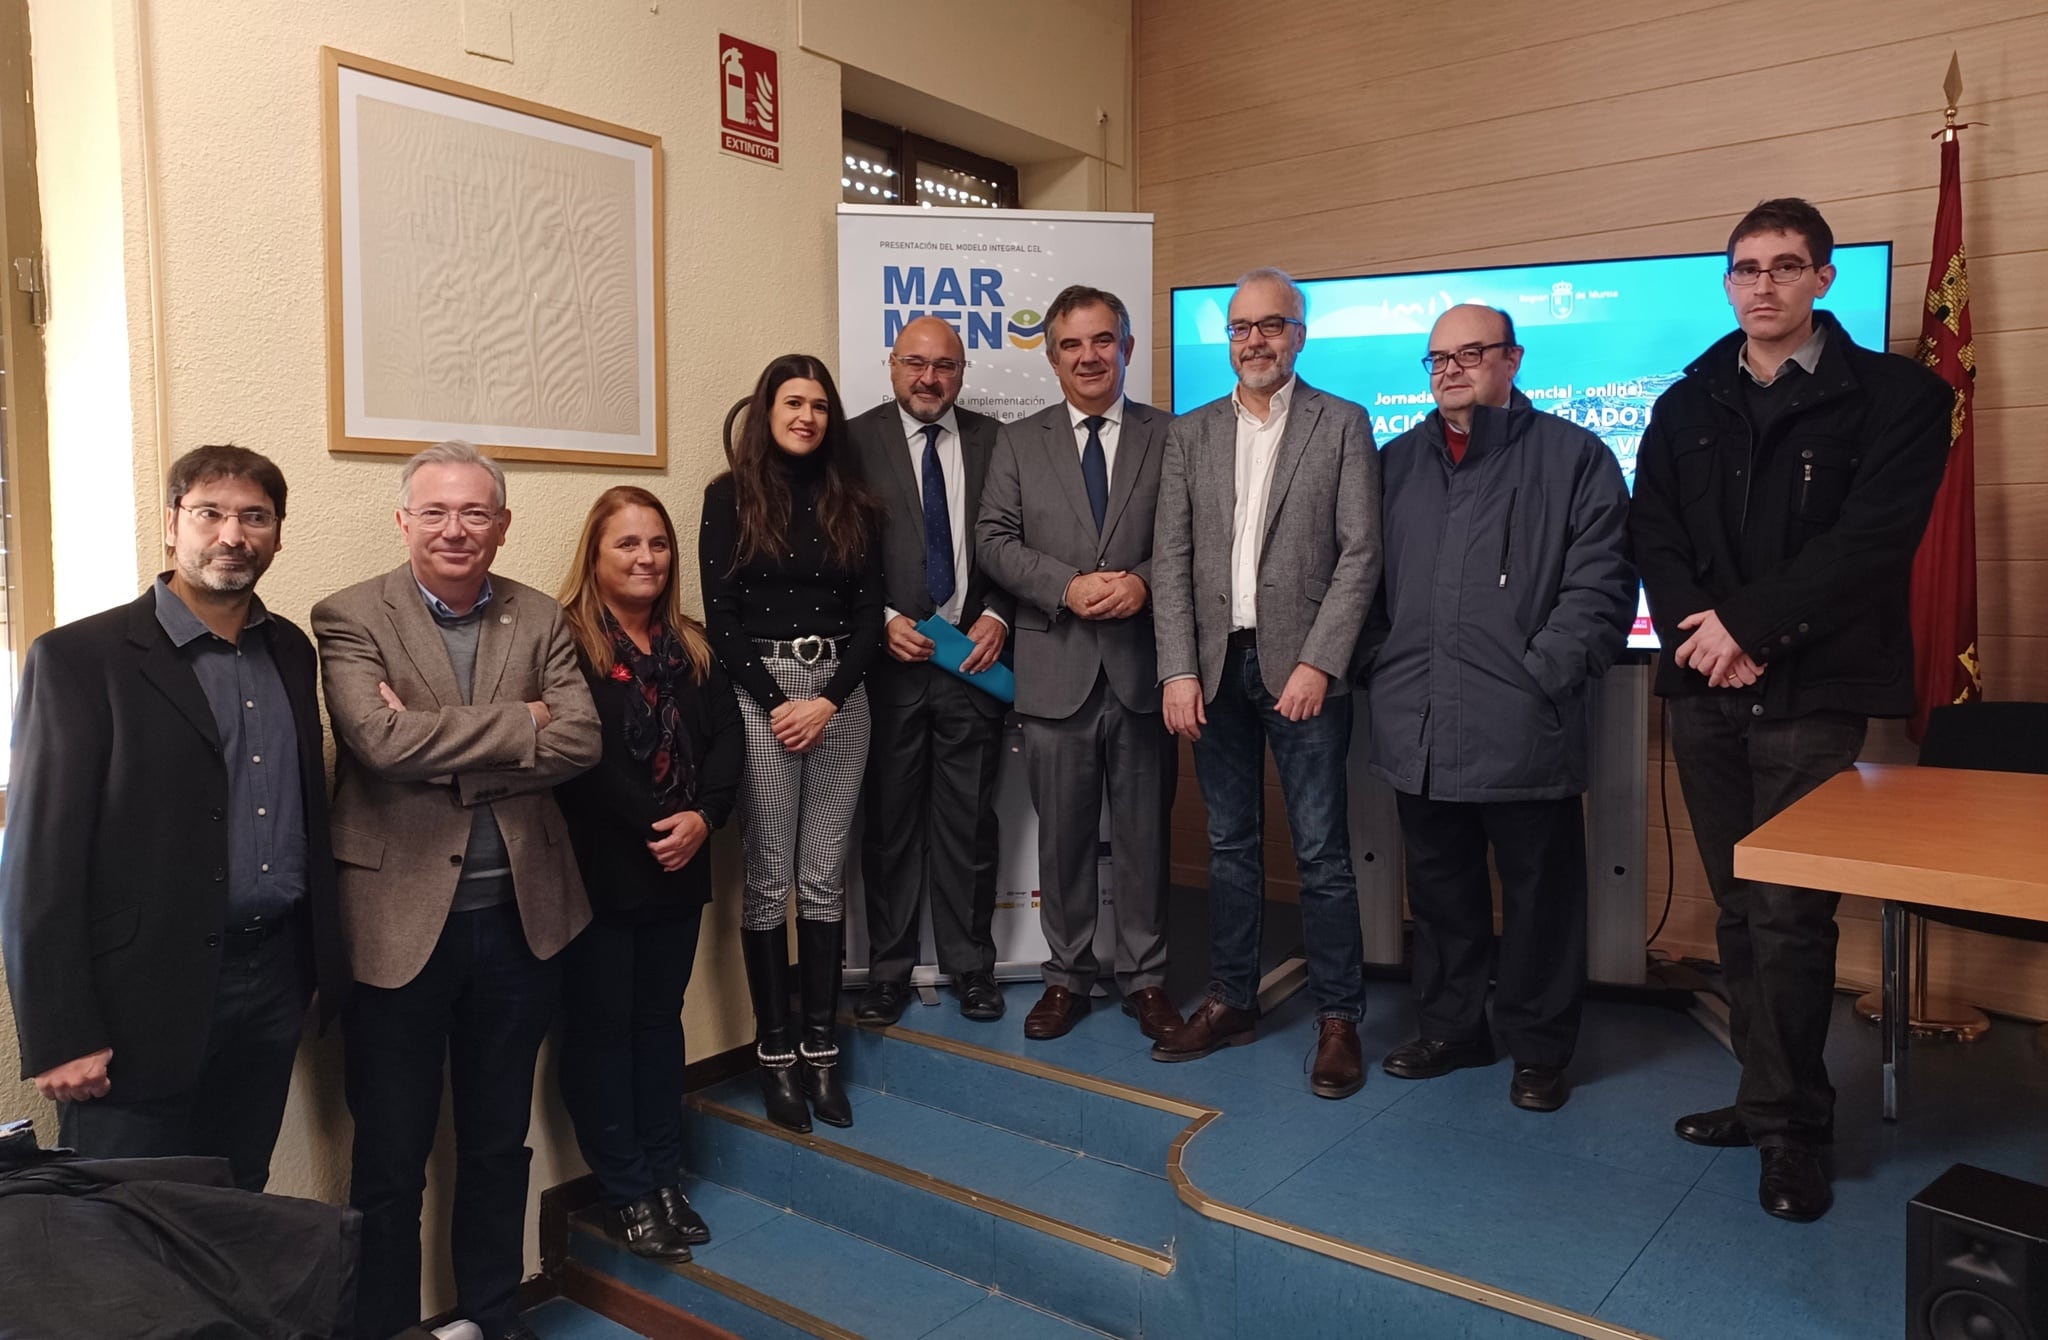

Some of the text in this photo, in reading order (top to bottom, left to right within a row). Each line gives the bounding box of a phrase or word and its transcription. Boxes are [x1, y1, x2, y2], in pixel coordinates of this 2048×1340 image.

[725, 136, 775, 160] EXTINTOR
[879, 240, 1043, 253] PRESENTACIÓN DEL MODELO INTEGRAL DEL
[883, 265, 1006, 307] MAR
[967, 395, 1045, 407] implementación
[1002, 411, 1015, 419] en
[1017, 409, 1026, 419] el
